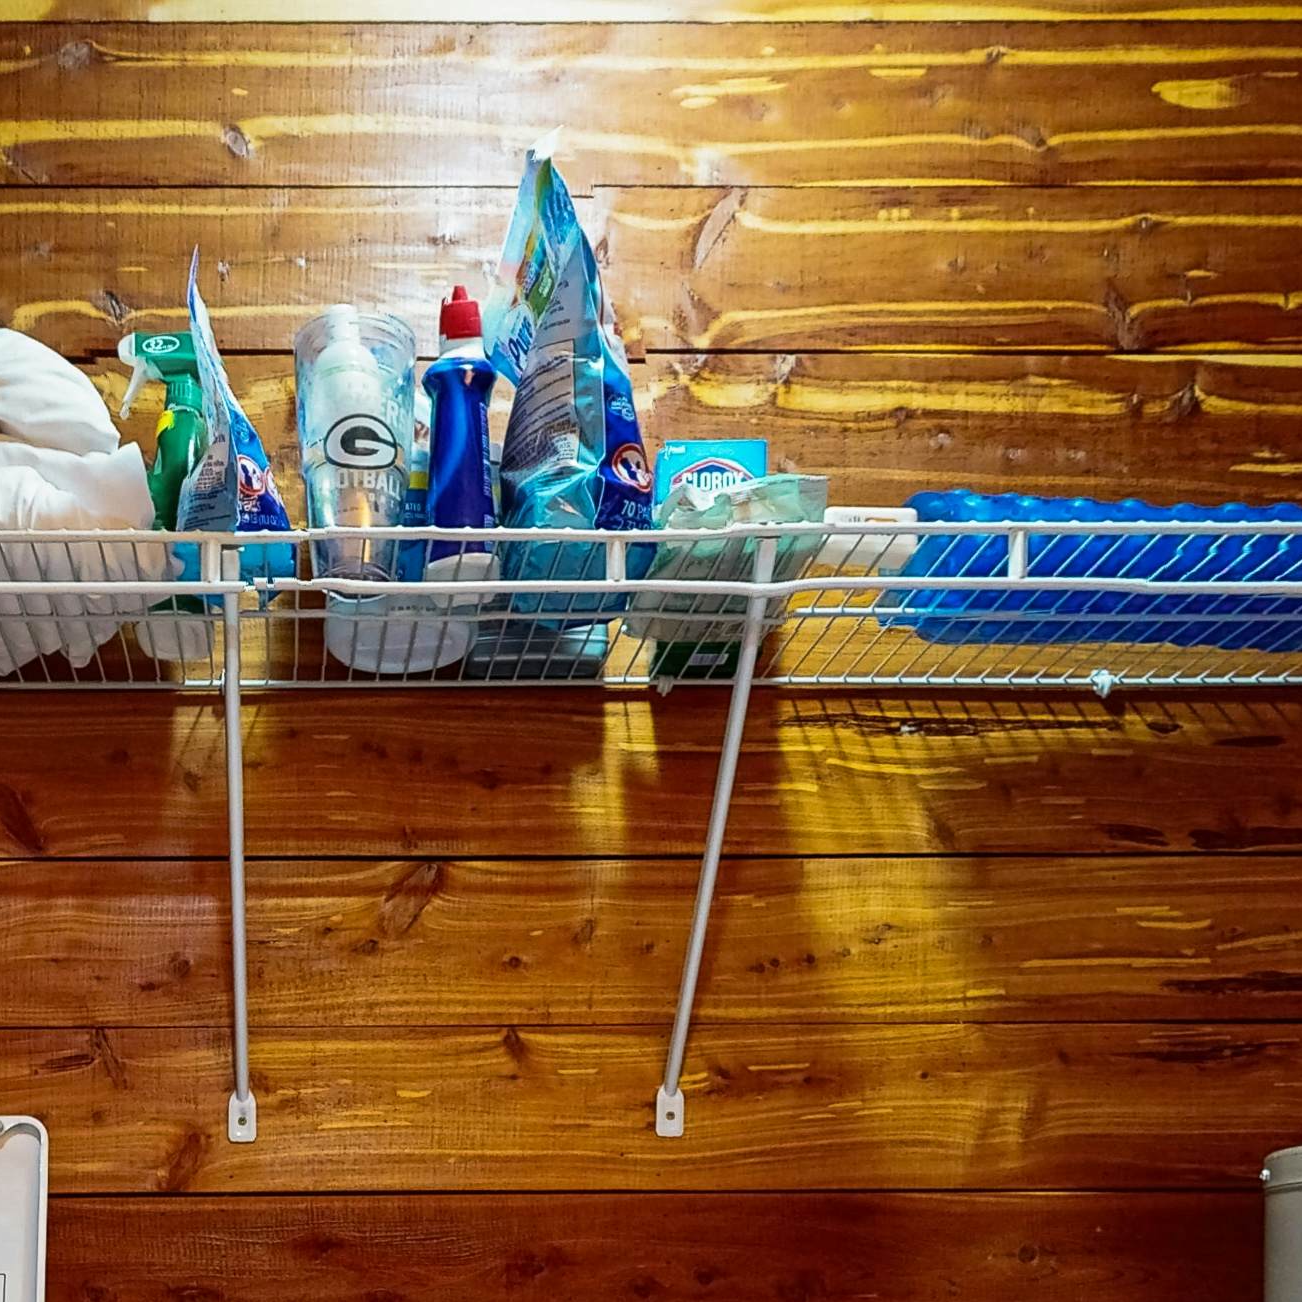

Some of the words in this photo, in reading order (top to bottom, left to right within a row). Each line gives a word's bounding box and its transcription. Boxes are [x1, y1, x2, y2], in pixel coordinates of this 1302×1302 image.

[148, 339, 163, 350] 32
[324, 414, 397, 470] G
[681, 471, 744, 490] CLOROX
[621, 499, 636, 517] 70
